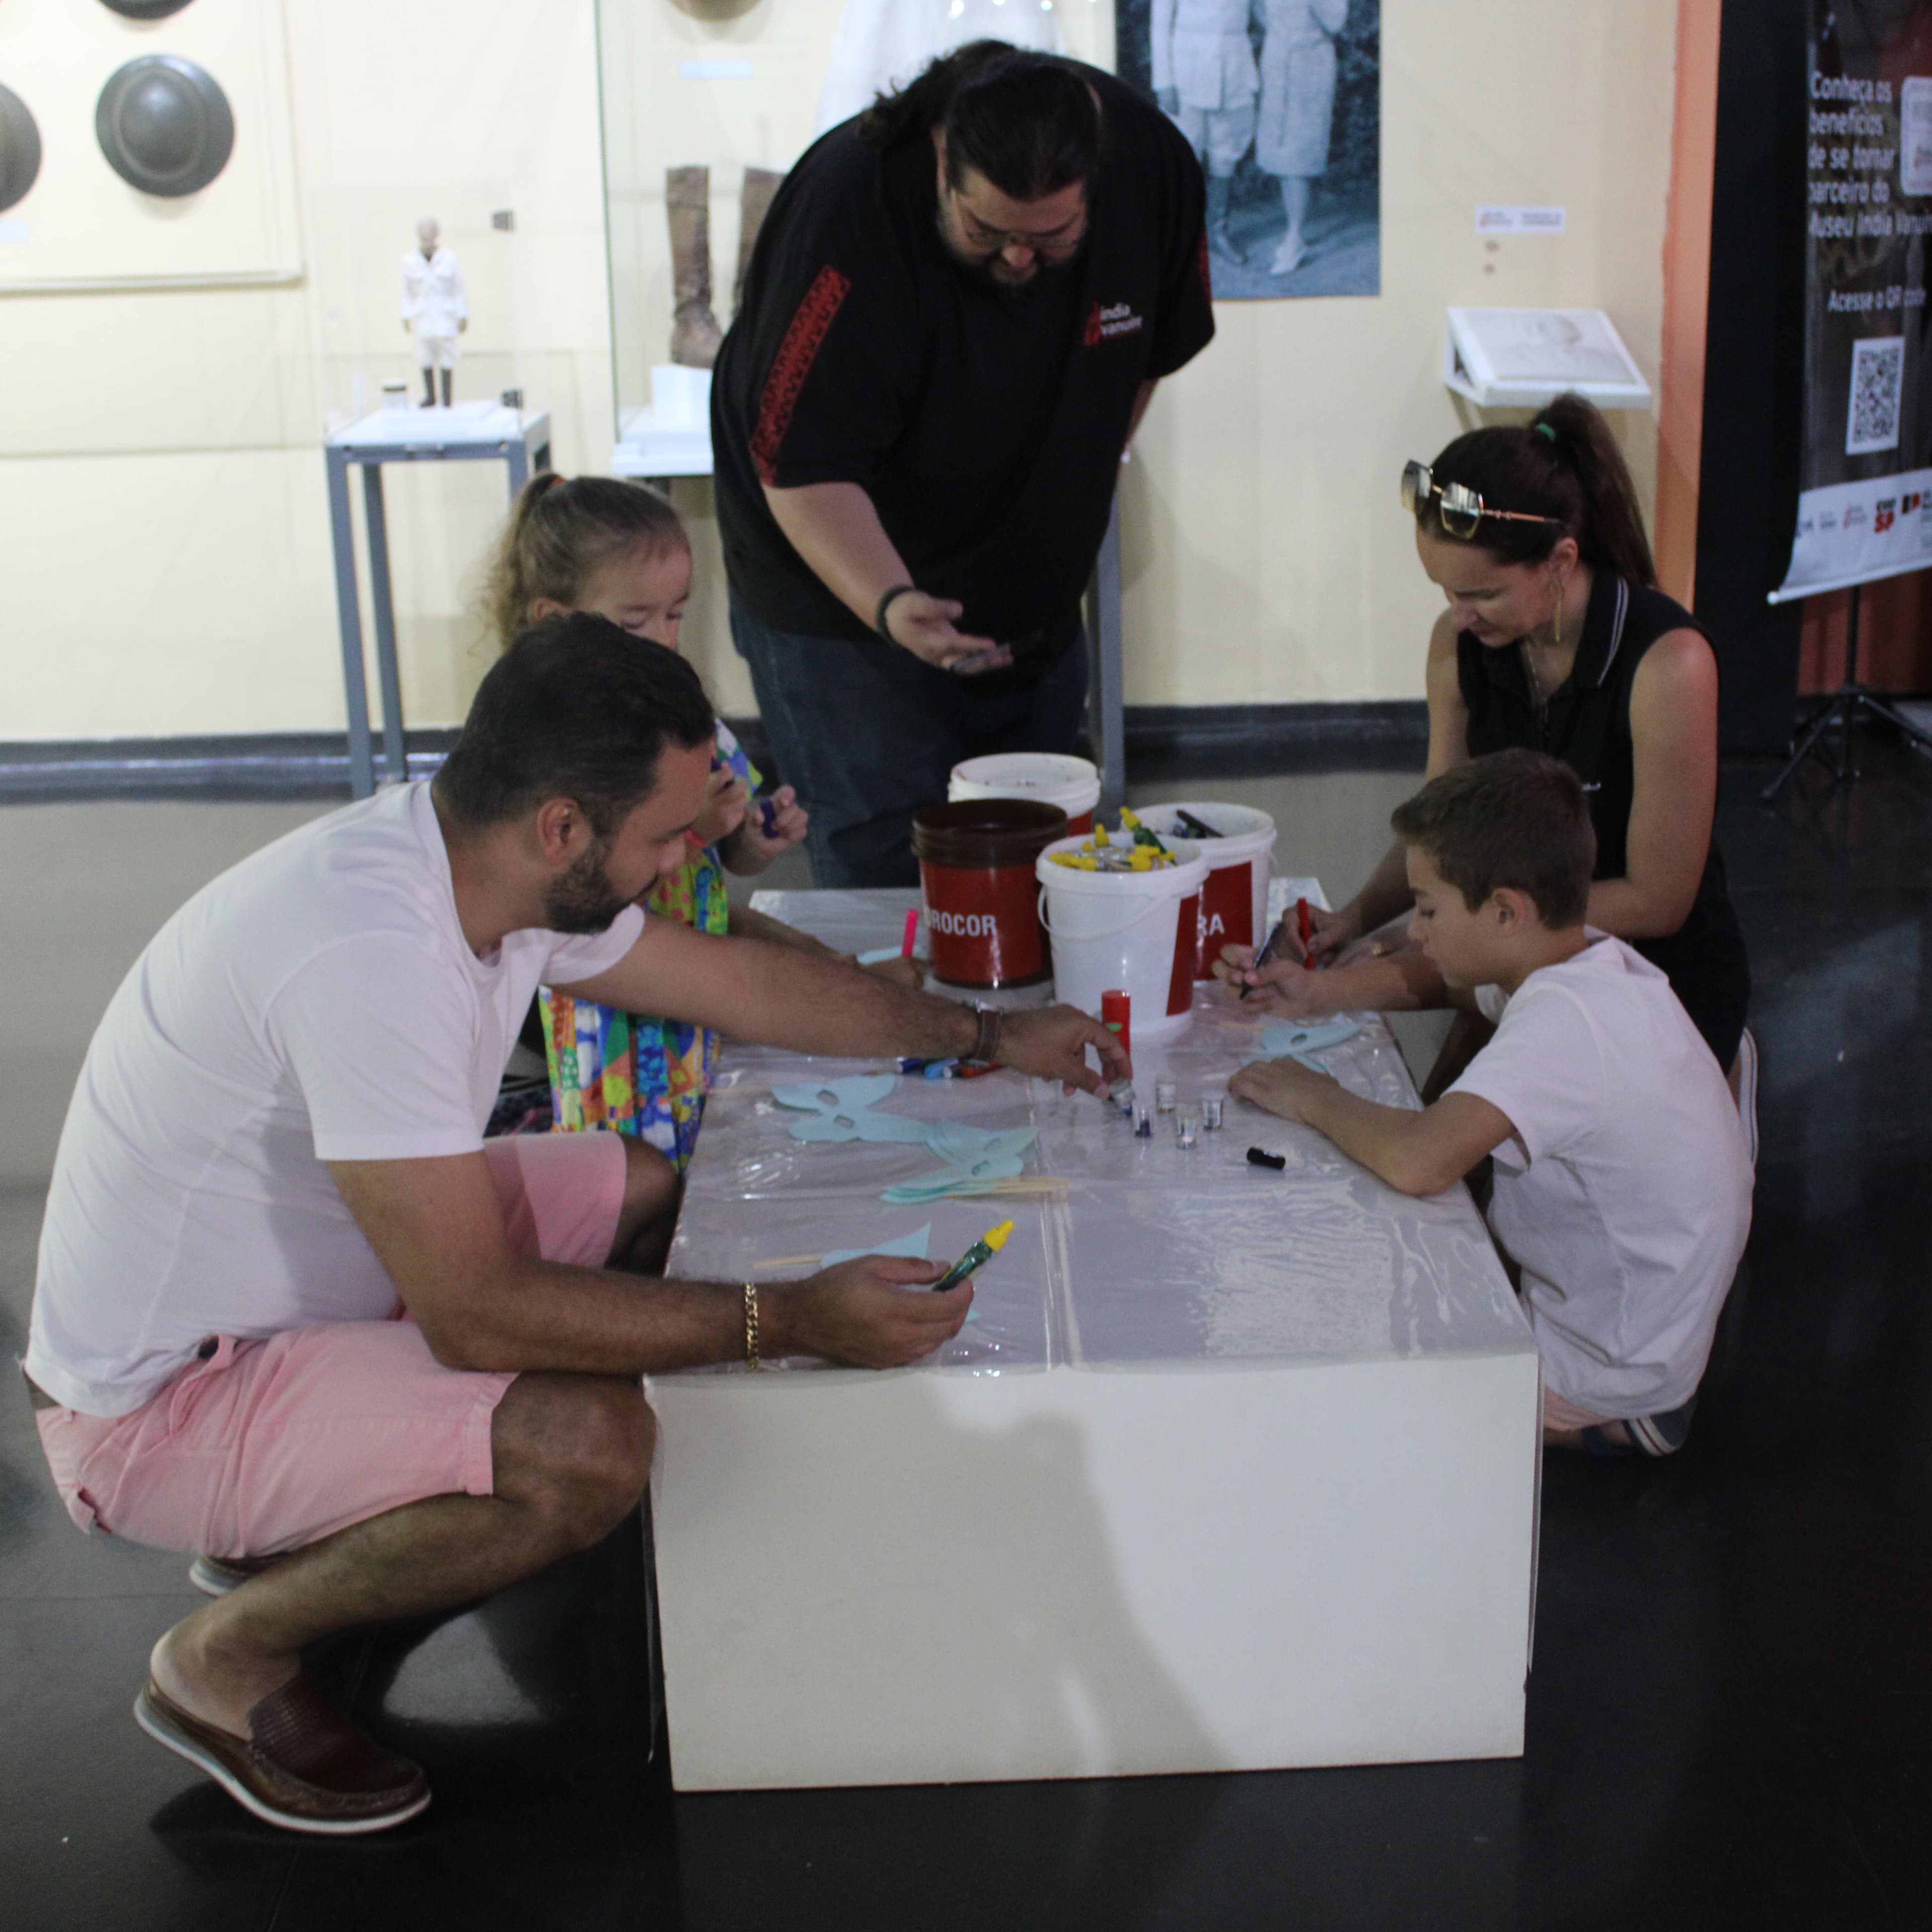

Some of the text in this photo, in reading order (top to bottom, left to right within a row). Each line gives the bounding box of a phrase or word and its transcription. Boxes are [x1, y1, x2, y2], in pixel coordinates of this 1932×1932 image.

[1811, 71, 1892, 107] Conheça os
[1829, 147, 1850, 170] se
[1872, 178, 1890, 203] do
[1827, 289, 1873, 312] Acesse
[1875, 291, 1884, 310] o
